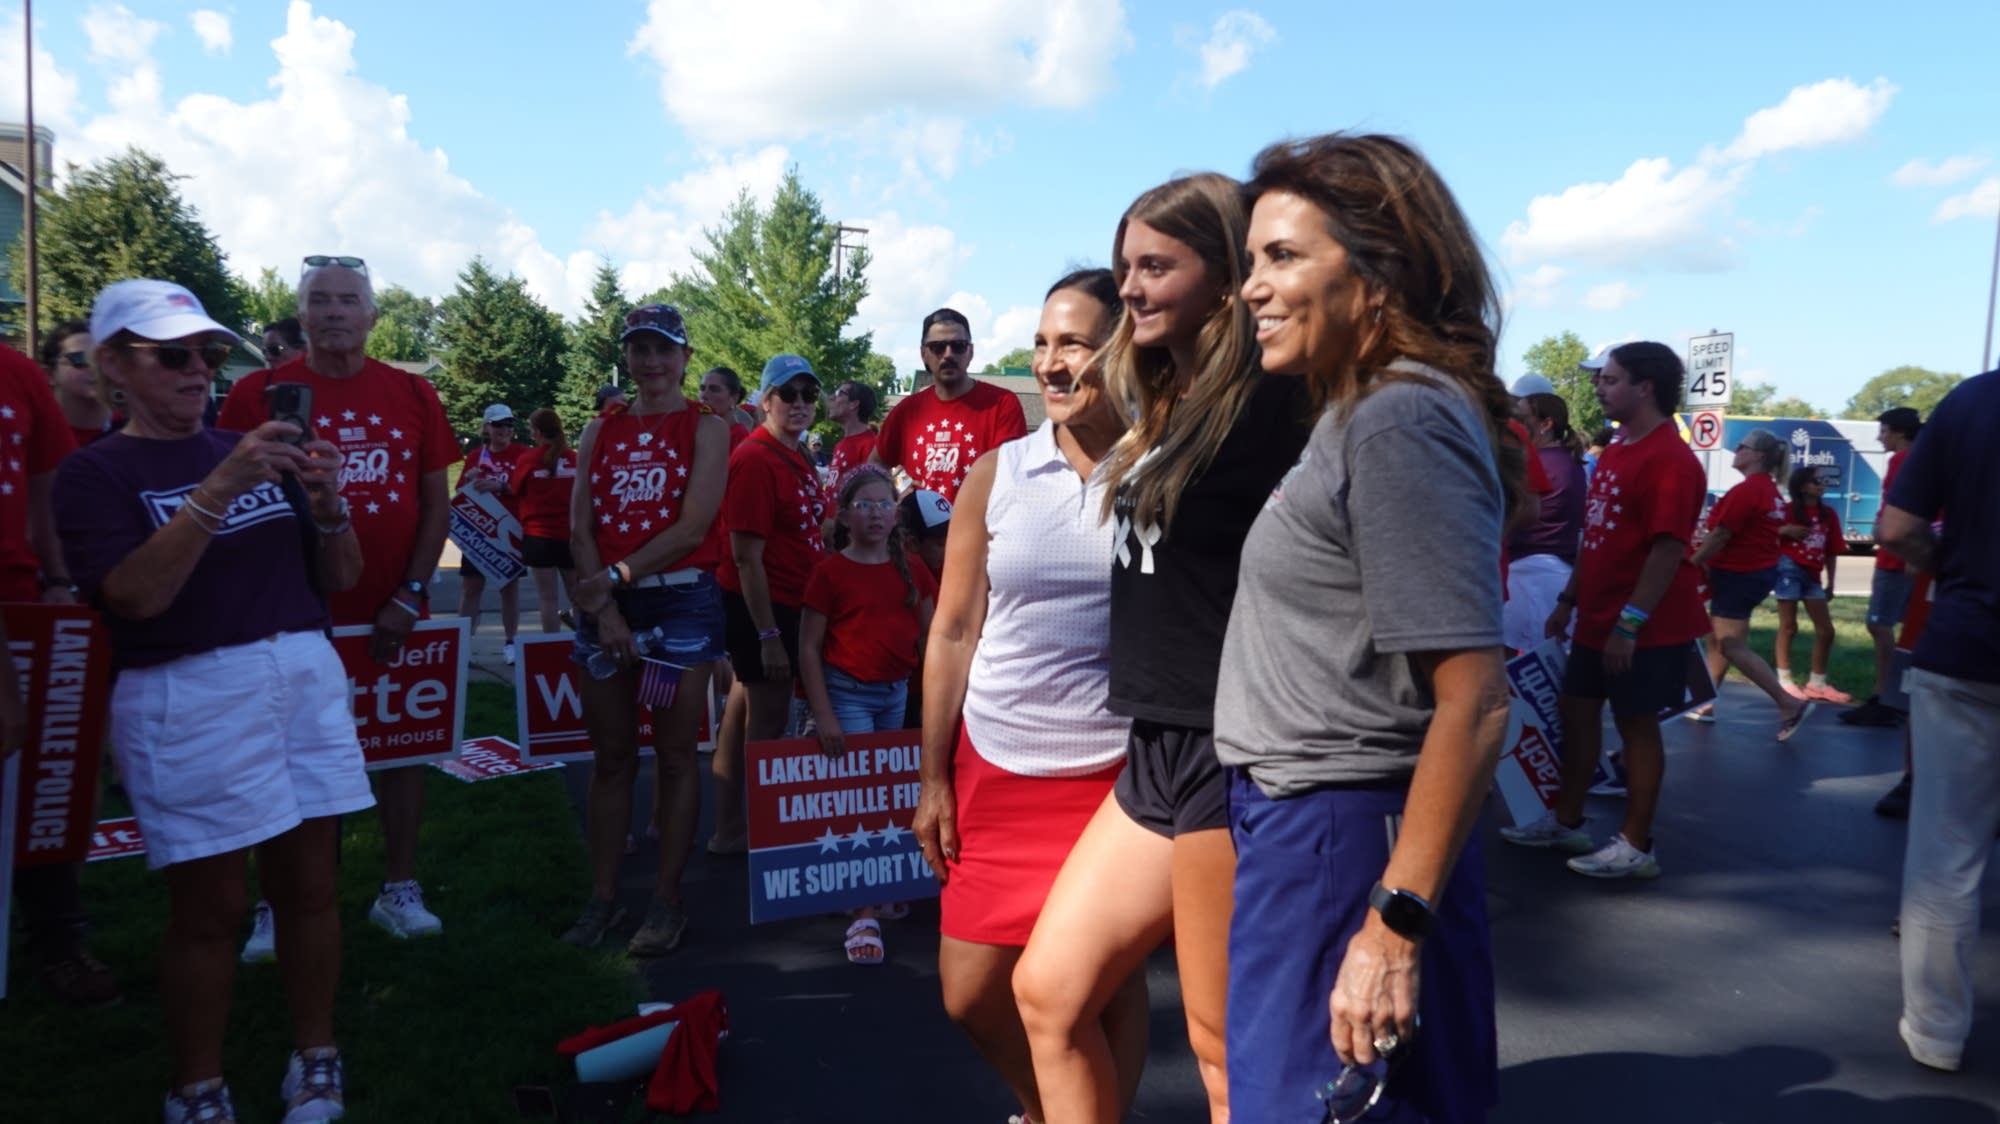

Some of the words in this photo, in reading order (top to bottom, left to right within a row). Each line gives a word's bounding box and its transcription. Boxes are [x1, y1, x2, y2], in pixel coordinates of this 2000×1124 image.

[1692, 342, 1729, 356] SPEED
[1695, 356, 1724, 370] LIMIT
[1690, 371, 1727, 397] 45
[346, 449, 389, 473] 50
[925, 447, 960, 468] 250
[610, 467, 667, 496] 250
[618, 485, 665, 513] years
[459, 498, 497, 533] Zach
[388, 640, 450, 668] Jeff
[40, 619, 92, 755] LAKEVILLE
[347, 673, 449, 727] tte
[357, 737, 381, 751] OR
[387, 728, 446, 747] HOUSE
[759, 750, 870, 786] LAKEVILLE
[875, 745, 921, 774] POLI
[28, 760, 76, 853] POLICE
[778, 786, 889, 823] LAKEVILLE
[893, 782, 922, 811] FIR
[763, 867, 801, 900] WE
[805, 854, 905, 895] SUPPORT
[908, 851, 935, 880] YO
